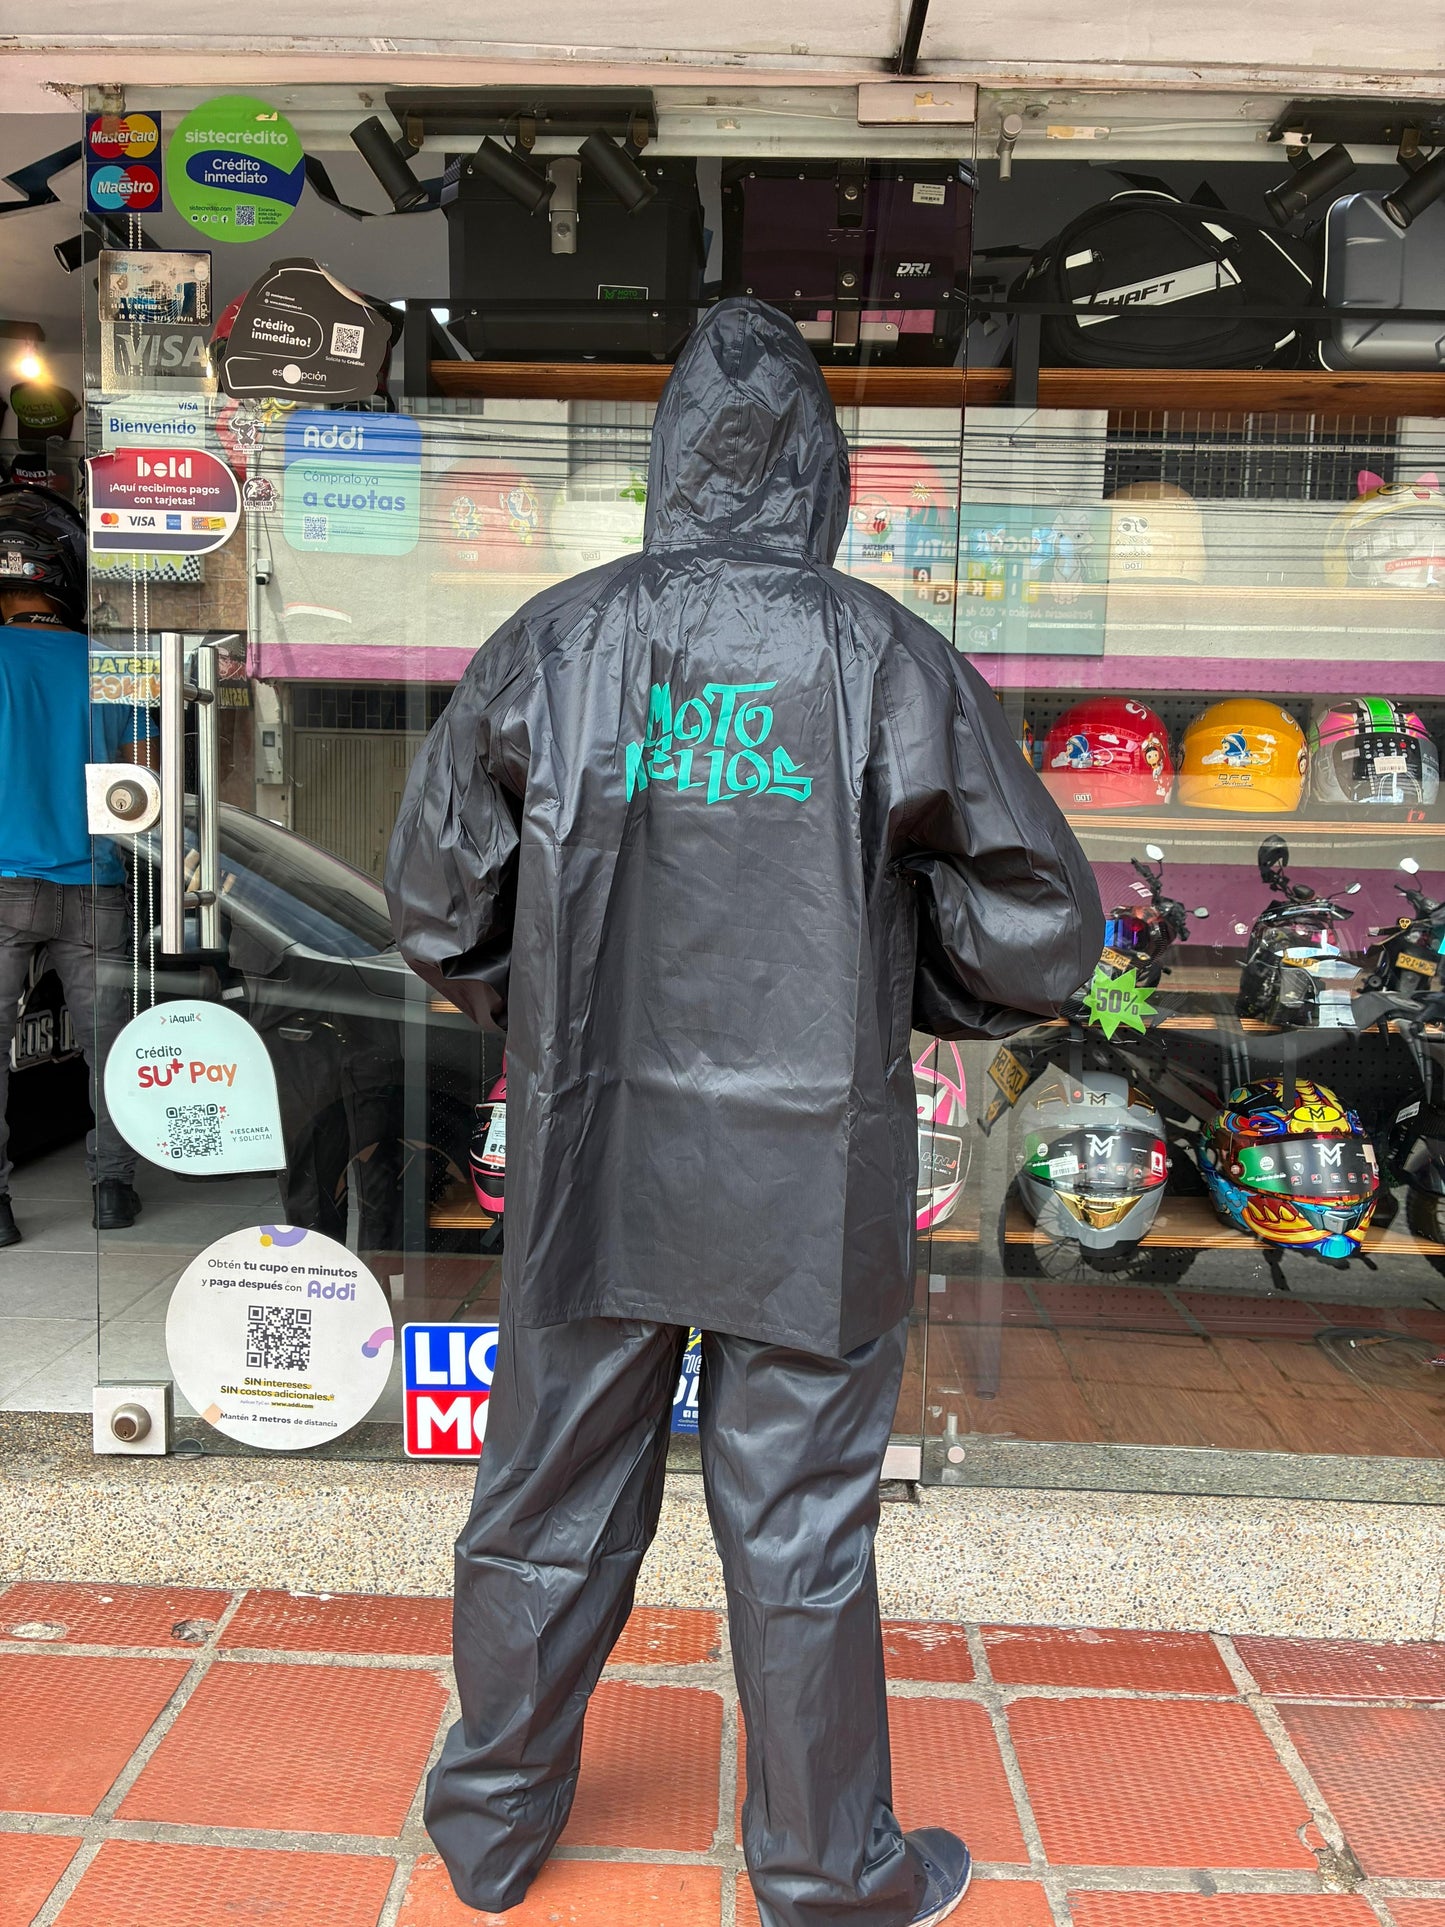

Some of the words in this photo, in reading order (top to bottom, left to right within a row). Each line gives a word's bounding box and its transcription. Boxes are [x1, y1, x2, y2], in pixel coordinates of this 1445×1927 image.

[91, 130, 157, 144] MasterCard
[185, 129, 288, 145] sistecrédito
[212, 159, 260, 171] Crédito
[204, 171, 268, 184] inmediato
[97, 181, 154, 194] Maestro
[253, 317, 295, 333] Crédito
[251, 328, 312, 348] inmediato!
[116, 333, 208, 367] VISA
[178, 402, 198, 410] VISA
[109, 418, 197, 434] Bienvenido
[304, 425, 365, 450] Addi
[16, 468, 56, 479] HONDA
[137, 456, 192, 478] bold
[303, 471, 362, 485] Cómpralo
[364, 475, 379, 487] ya
[109, 483, 136, 494] ¡Aquí
[138, 484, 187, 493] recibimos
[189, 486, 220, 496] pagos
[155, 496, 196, 506] tarjetas!
[303, 491, 317, 507] a
[324, 489, 406, 511] cuotas
[127, 516, 156, 527] VISA
[646, 680, 778, 752] MOTO
[1096, 987, 1139, 1016] 50%
[169, 1013, 195, 1024] ¡Aquí!
[135, 1046, 182, 1060] Crédito
[189, 1061, 238, 1088] Pay
[239, 1134, 273, 1142] SOLICITA!
[208, 1258, 241, 1270] Obtén
[243, 1261, 257, 1270] tu
[259, 1263, 288, 1276] cupo
[290, 1265, 305, 1274] en
[307, 1264, 358, 1278] minutos
[201, 1279, 208, 1287] y
[209, 1279, 236, 1288] paga
[238, 1278, 283, 1291] después
[284, 1284, 302, 1292] con
[307, 1280, 356, 1301] Addi
[220, 1385, 238, 1394] SIN
[240, 1387, 272, 1397] costos
[244, 1377, 262, 1386] SIN
[263, 1379, 311, 1390] intereses.
[220, 1412, 249, 1421] Mantén
[251, 1414, 258, 1422] 2
[259, 1415, 291, 1424] metros
[293, 1417, 303, 1425] de
[304, 1417, 338, 1428] distancia
